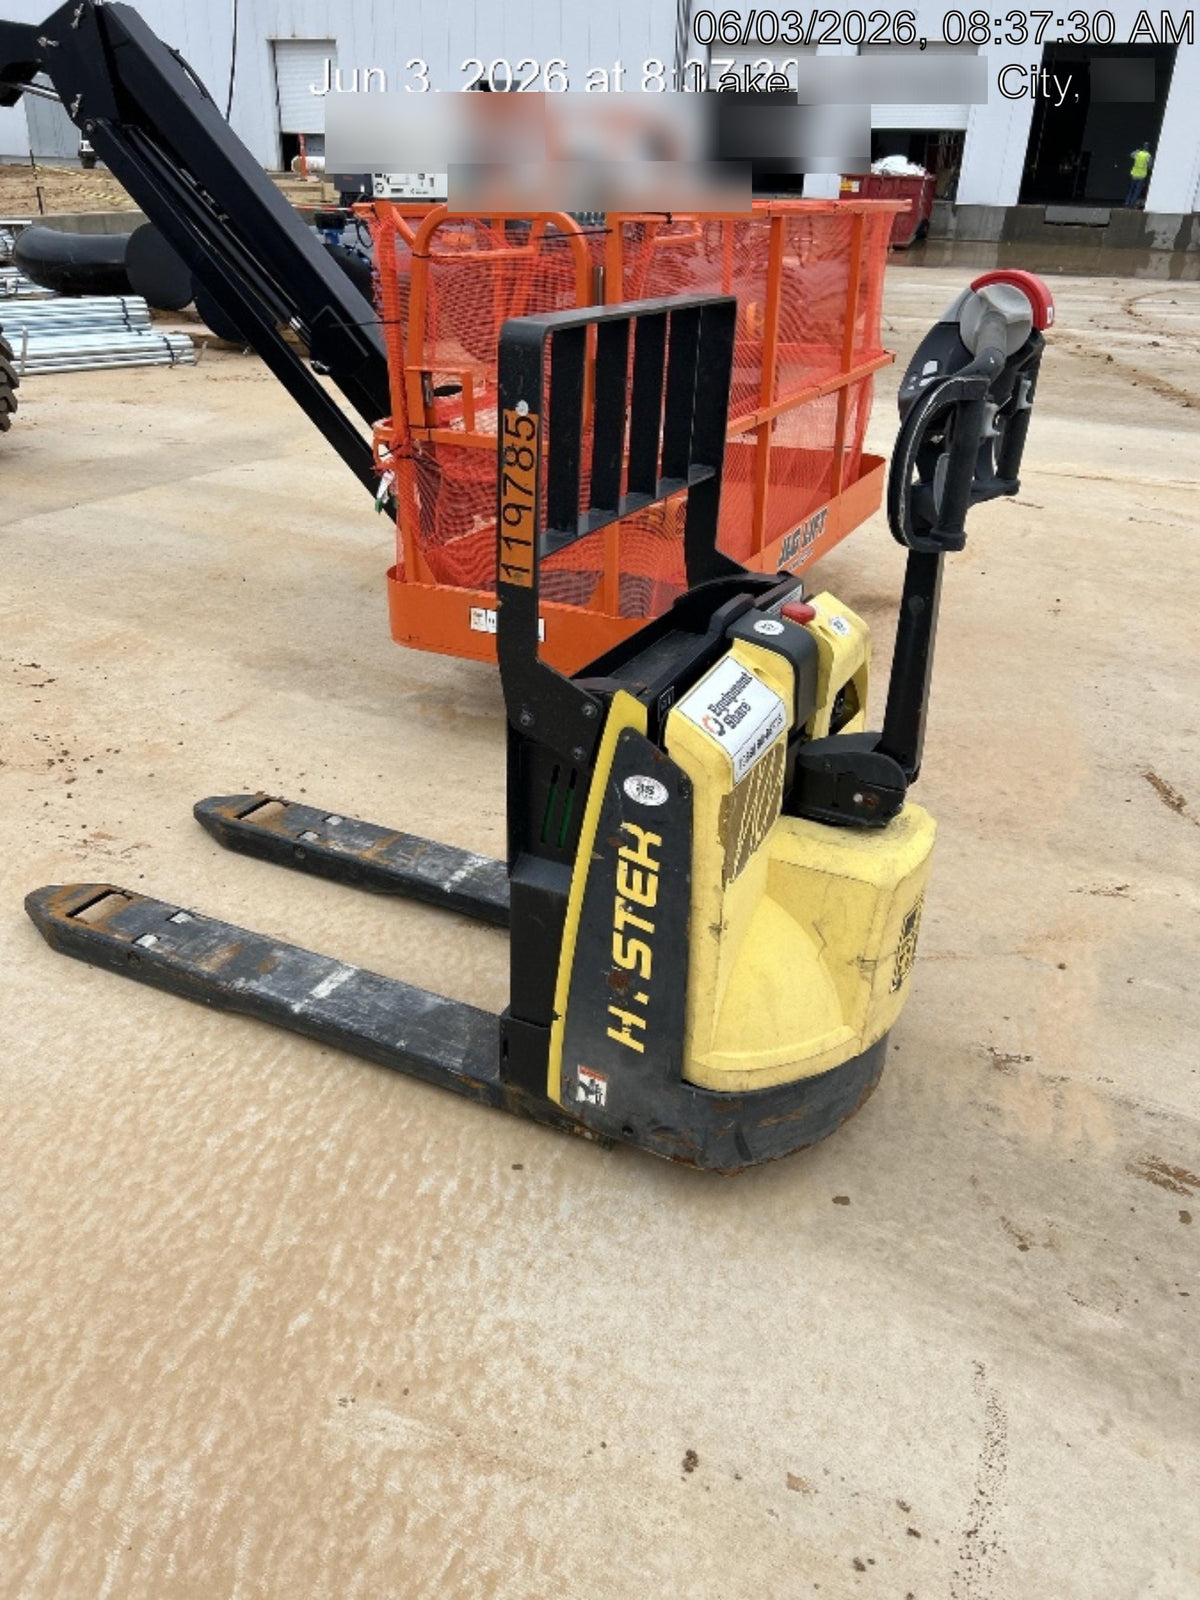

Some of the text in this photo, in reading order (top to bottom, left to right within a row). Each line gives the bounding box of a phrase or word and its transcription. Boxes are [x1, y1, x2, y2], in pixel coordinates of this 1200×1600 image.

[501, 414, 536, 578] 119785
[707, 671, 753, 717] Equipment
[723, 701, 752, 729] Share
[607, 821, 662, 1053] HSTER
